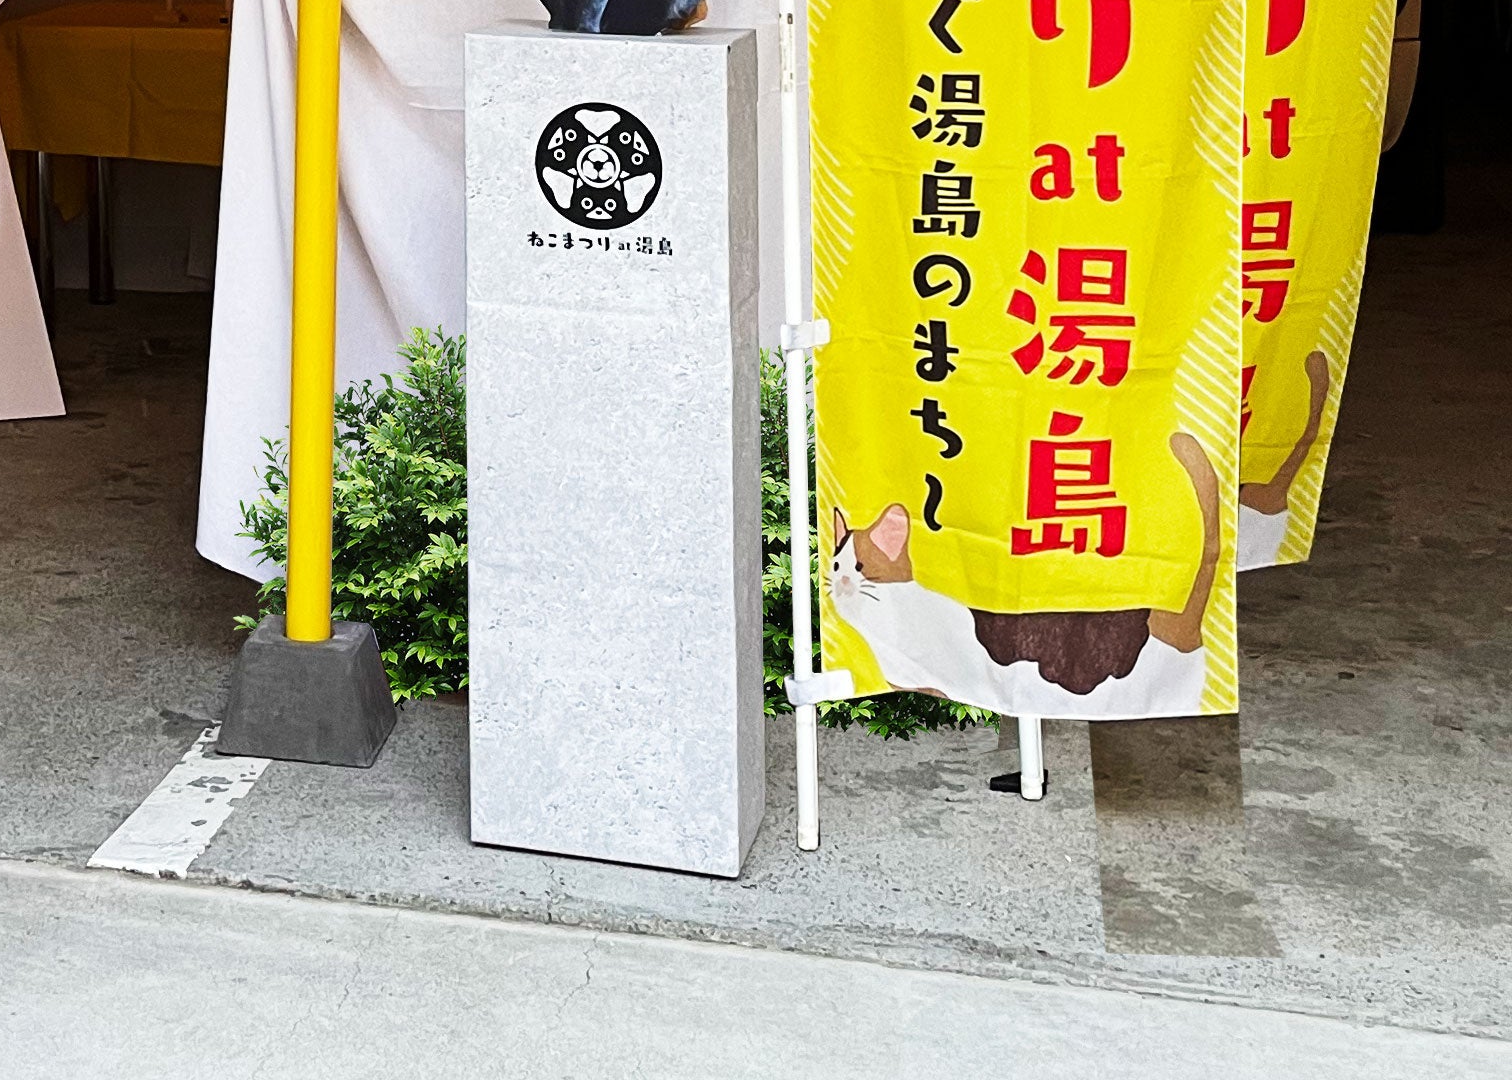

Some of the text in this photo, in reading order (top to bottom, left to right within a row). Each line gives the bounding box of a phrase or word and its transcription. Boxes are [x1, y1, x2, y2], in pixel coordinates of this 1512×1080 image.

[1030, 134, 1125, 203] at
[527, 231, 610, 251] ねこまつり
[636, 236, 673, 256] 湯島
[1006, 247, 1137, 559] 湯島
